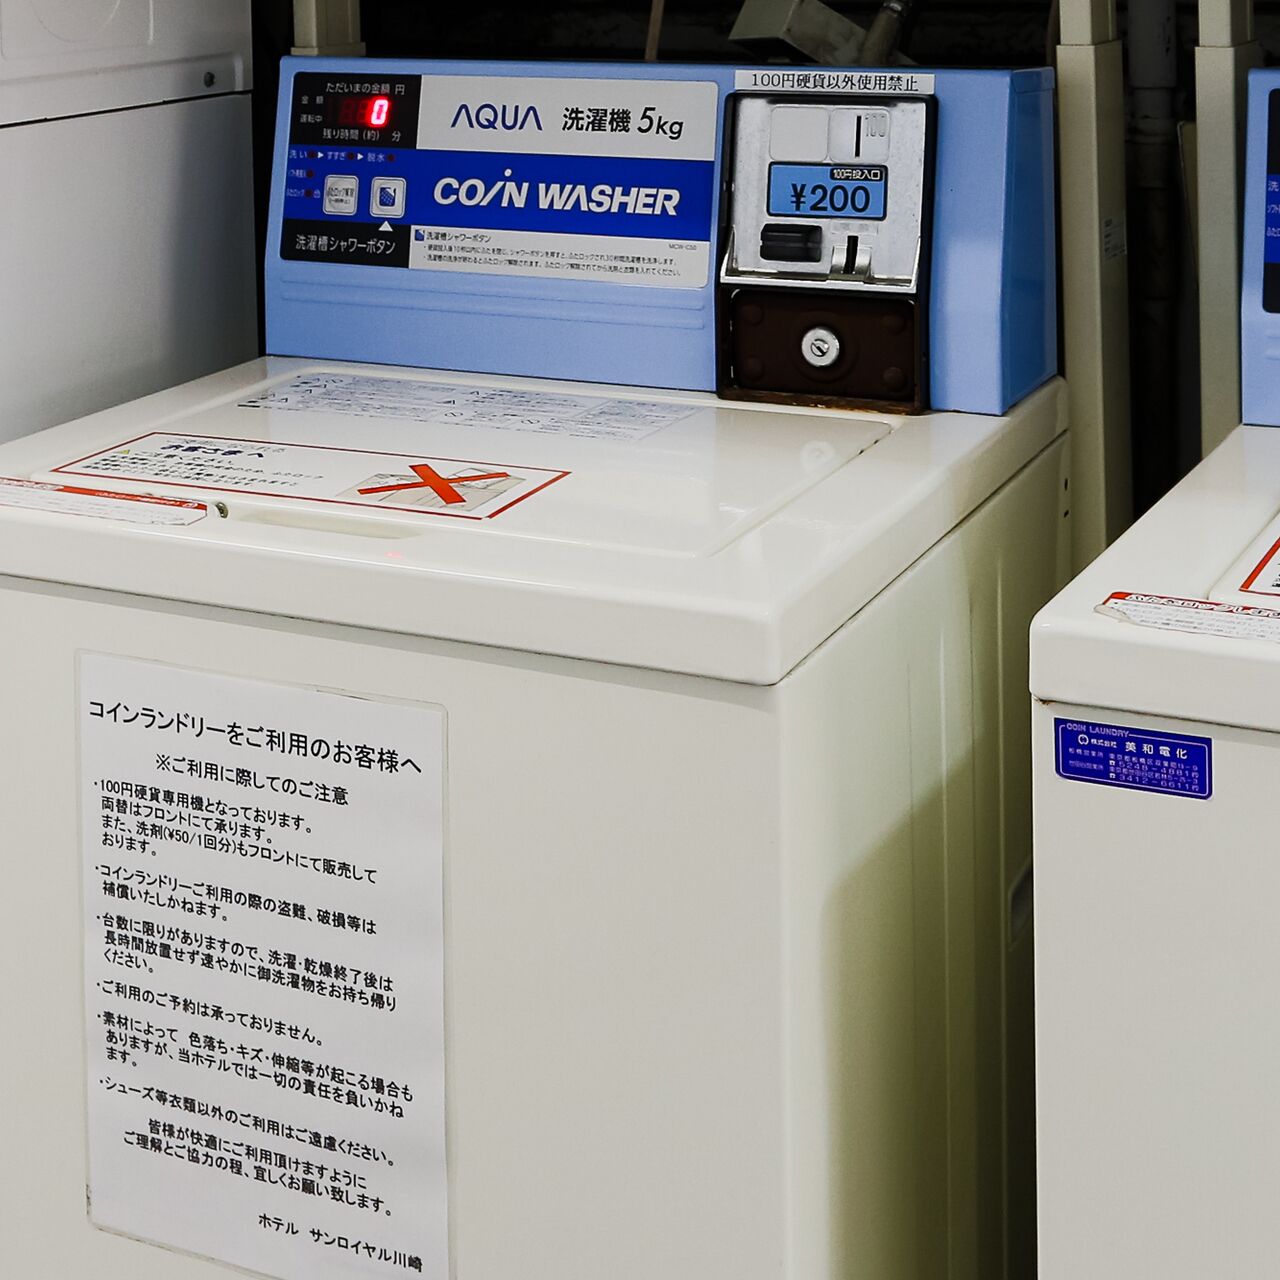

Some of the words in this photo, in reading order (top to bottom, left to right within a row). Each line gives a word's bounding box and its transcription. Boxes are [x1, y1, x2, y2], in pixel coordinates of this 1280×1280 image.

[326, 82, 391, 95] ただいまの金額
[395, 84, 406, 96] 円
[751, 73, 919, 93] 100円硬貨以外使用禁止
[322, 128, 380, 142] 残り時間(約)
[392, 130, 402, 142] 分
[371, 99, 389, 125] 0
[450, 104, 543, 131] AQUA
[561, 107, 632, 134] 洗濯機
[637, 107, 684, 140] 5kg
[433, 168, 529, 208] COIN
[538, 182, 681, 216] WASHER
[790, 183, 870, 213] ¥200
[832, 169, 881, 180] 100円投入口
[296, 234, 396, 255] 洗濯槽シャワーボタン
[88, 701, 422, 774] コインランドリーをご利用のお客様へ
[1089, 726, 1130, 738] LAUNDRY
[1125, 741, 1188, 760] 美和電化
[155, 753, 350, 806] ※ご利用に際してのご注意
[94, 778, 312, 834] ・100円硬貨専用機となっております。
[101, 796, 273, 844] 両替はフロントにて承ります。
[101, 833, 158, 857] おります。
[101, 814, 378, 884] また、洗剤(¥50/1回分)もフロントにて販売して
[96, 864, 377, 936] ・コインランドリーご利用の際の盗難、破損等は
[102, 881, 228, 922] 補償いたしかねます。
[97, 912, 394, 993] ・台数に限りがありますので、洗濯・乾燥終了後は
[103, 948, 154, 974] ください。
[104, 930, 398, 1012] 長時間放置せず速やかに御洗濯物をお持ち帰り
[97, 979, 324, 1048] ・ご利用のご予約は承っておりません。
[97, 1011, 179, 1043] ・素材によって
[188, 1030, 415, 1103] 色落ち・キズ・伸縮等が起こる場合も
[105, 1046, 137, 1067] ます。
[105, 1030, 406, 1120] ありますが、当ホテルでは一切の責任を負いかね
[99, 1075, 395, 1167] ・シューズ等衣類以外のご利用はご遠慮ください。
[123, 1130, 392, 1217] ご理解とご協力の程、宜しくお願い致します。
[148, 1117, 368, 1190] 皆様が快適にご利用頂けますように
[258, 1214, 299, 1237] ホテル
[309, 1227, 424, 1273] サンロイヤル川崎
